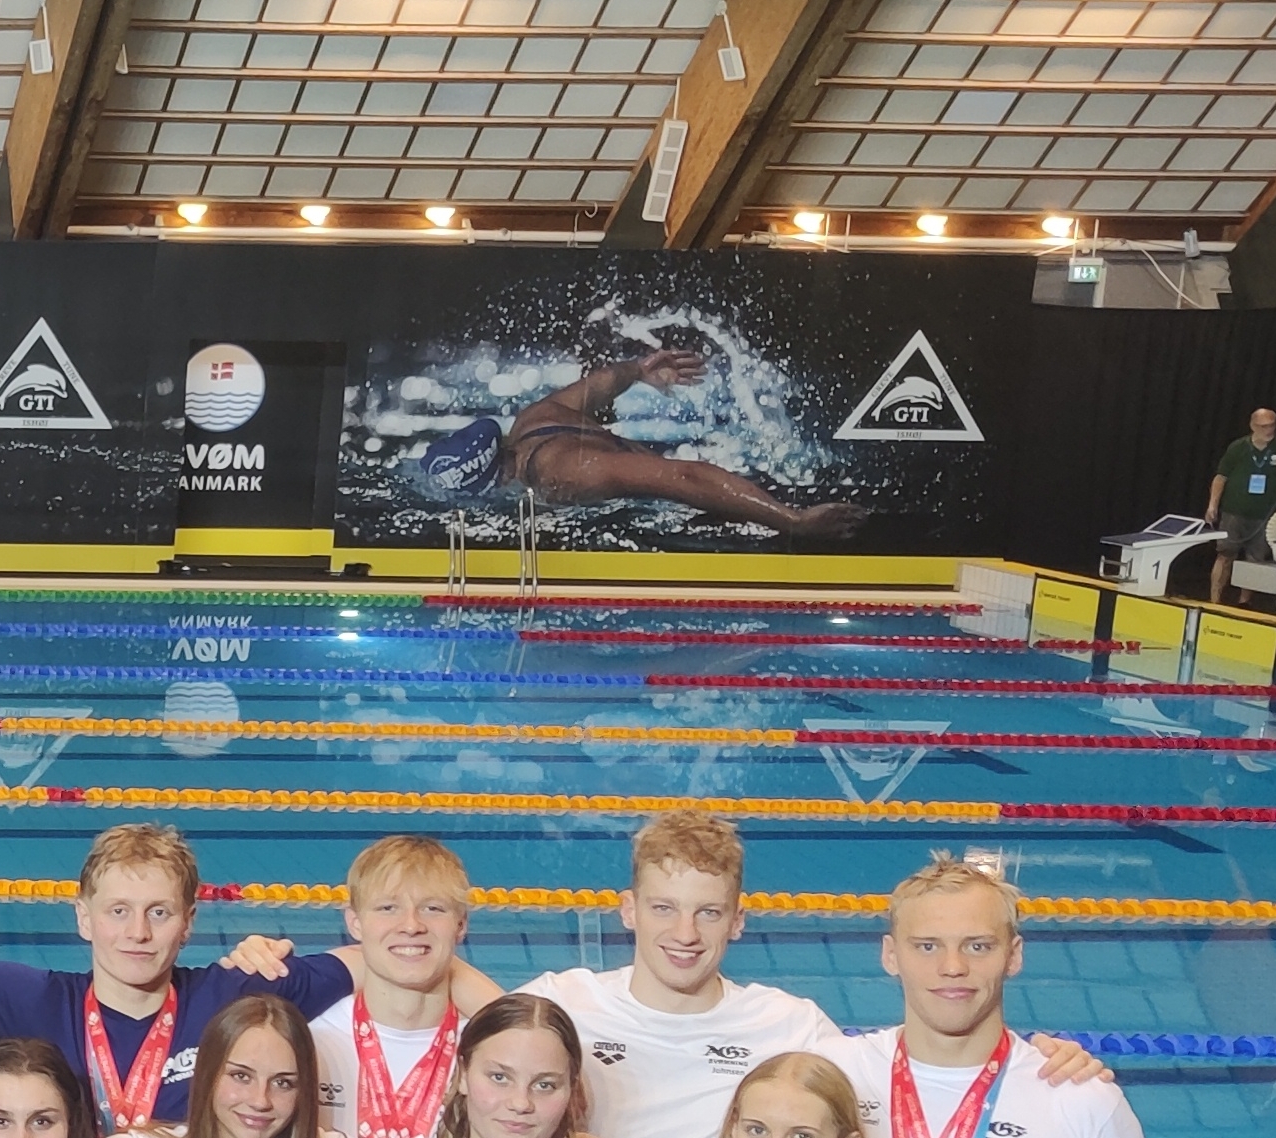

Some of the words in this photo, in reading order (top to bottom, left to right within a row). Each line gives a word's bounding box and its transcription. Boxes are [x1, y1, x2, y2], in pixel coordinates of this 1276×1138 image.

[63, 361, 80, 385] TUNE
[871, 371, 895, 398] GREVE
[19, 395, 55, 411] GTI
[894, 407, 930, 423] GTI
[186, 443, 265, 470] VØM
[178, 475, 263, 491] ANMARK
[1152, 560, 1162, 579] 1
[594, 1042, 626, 1052] arena
